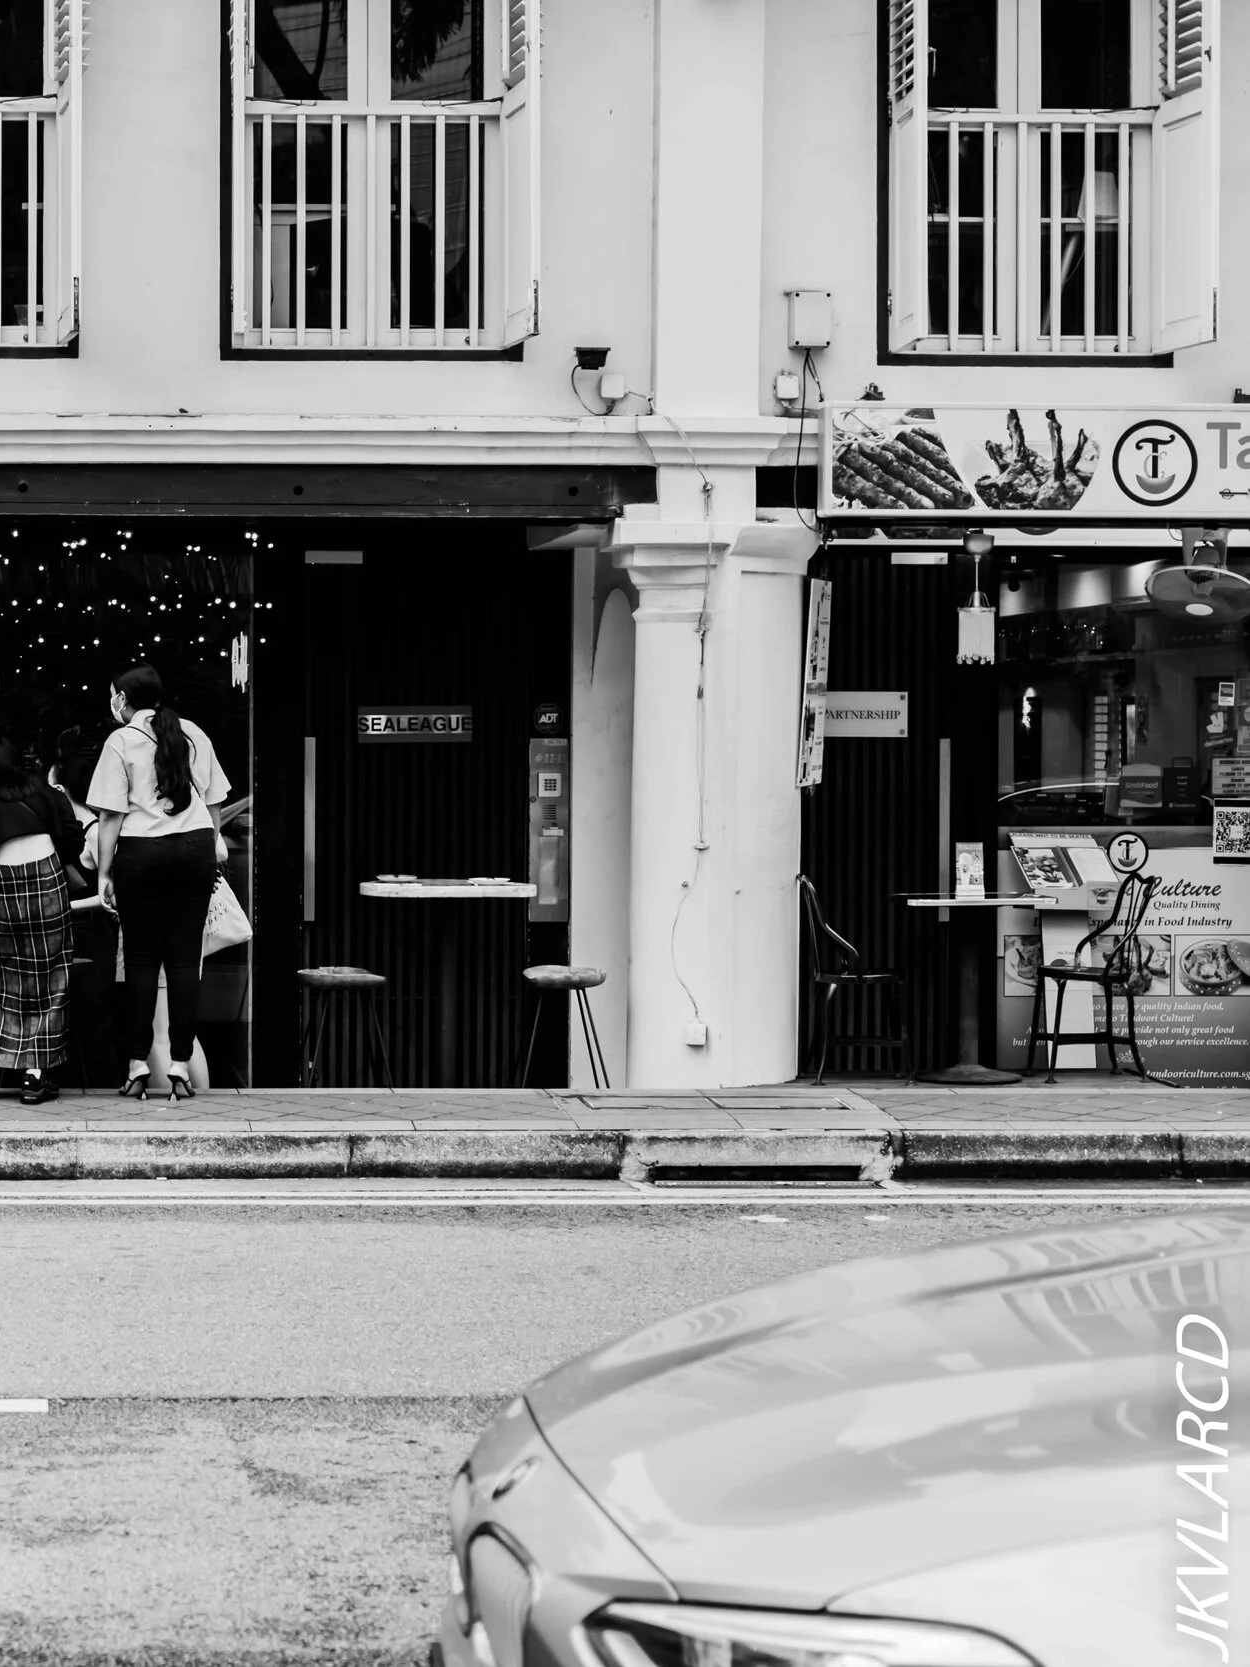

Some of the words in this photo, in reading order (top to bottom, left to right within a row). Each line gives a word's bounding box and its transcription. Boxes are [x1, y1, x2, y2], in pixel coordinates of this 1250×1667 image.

[538, 712, 559, 724] ADT
[357, 716, 473, 733] SEALEAGUE
[1153, 900, 1188, 911] Quality
[1190, 900, 1221, 911] Dining
[1144, 916, 1155, 927] in
[1157, 916, 1184, 927] Food
[1187, 916, 1233, 928] Industry
[1141, 1002, 1172, 1012] quality
[1173, 1002, 1201, 1010] Indian
[1202, 1002, 1224, 1012] food,
[1160, 1013, 1194, 1022] Culture!
[1155, 1026, 1168, 1034] not
[1171, 1025, 1190, 1036] only
[1192, 1026, 1214, 1036] great
[1214, 1025, 1235, 1036] food
[1012, 1037, 1027, 1046] but
[1176, 1037, 1204, 1046] service
[1206, 1037, 1249, 1046] excellence.
